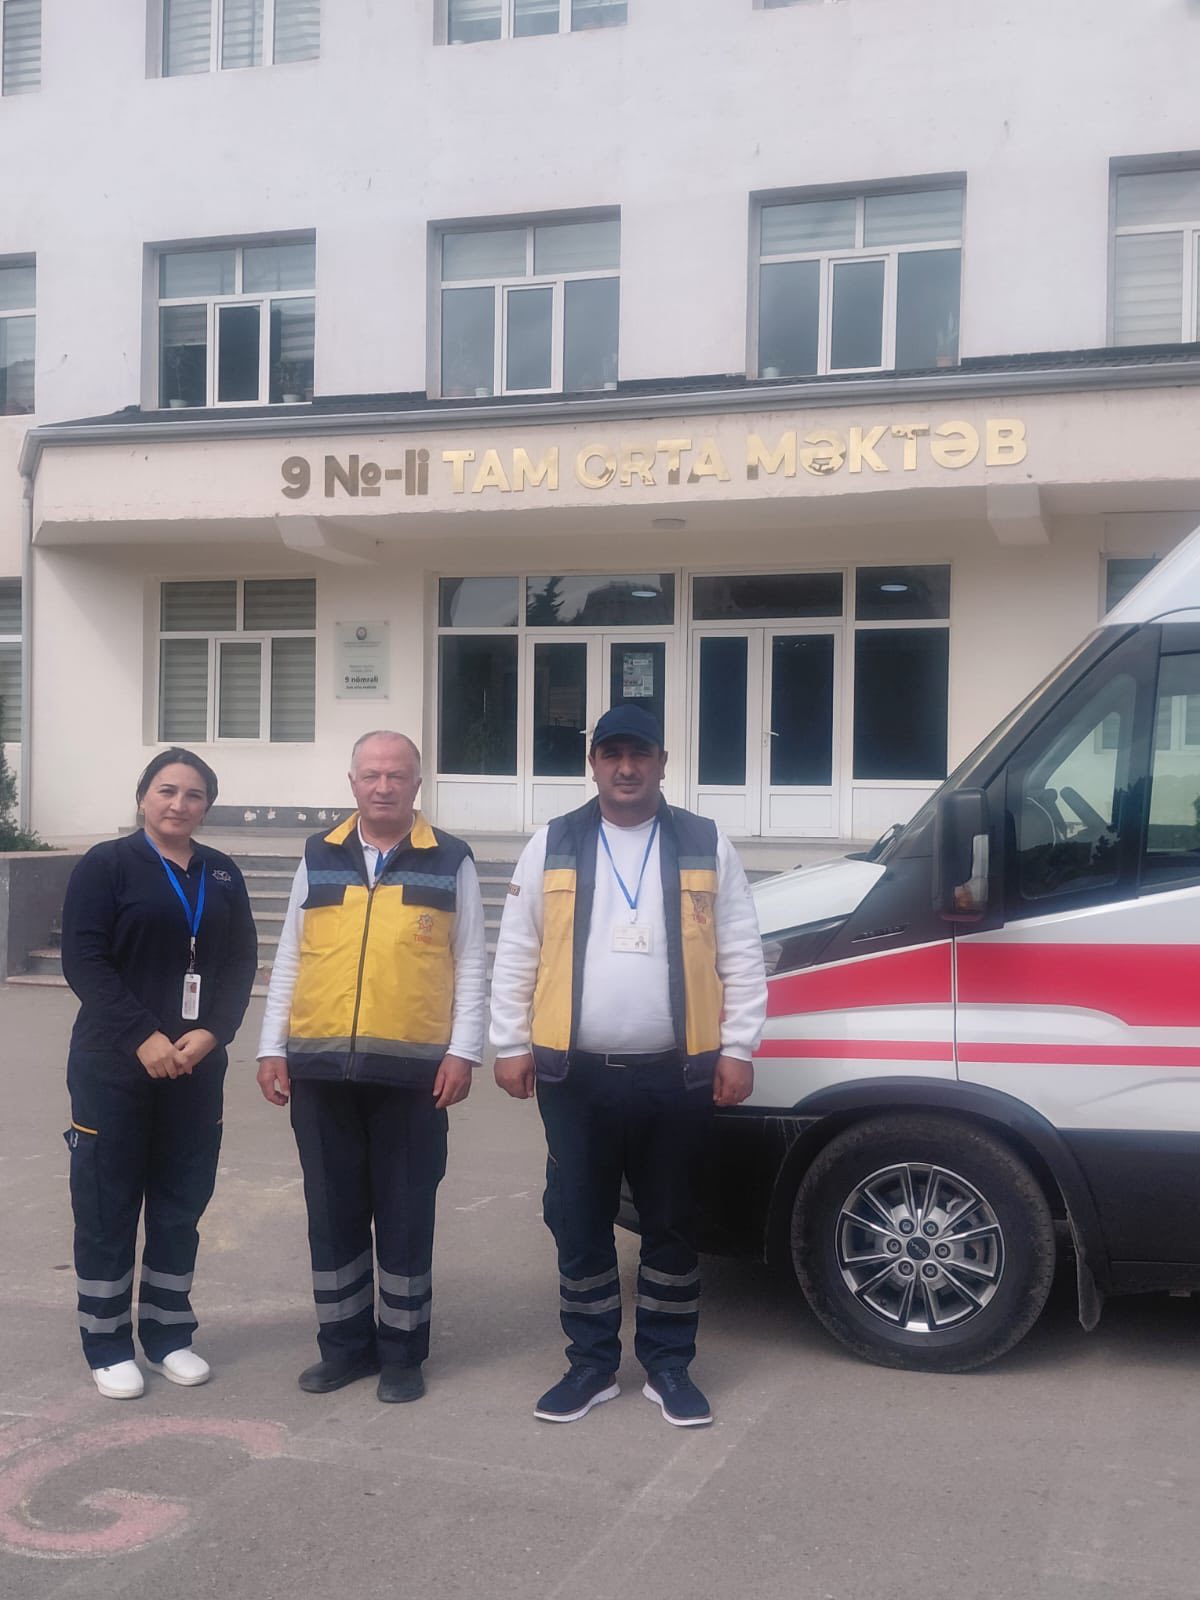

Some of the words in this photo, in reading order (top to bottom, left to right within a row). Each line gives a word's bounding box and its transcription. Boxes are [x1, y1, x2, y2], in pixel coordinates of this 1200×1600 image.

[281, 456, 310, 499] 9
[442, 447, 560, 494] TAM
[575, 437, 730, 490] ORTA
[746, 418, 1027, 480] MƏKTƏB
